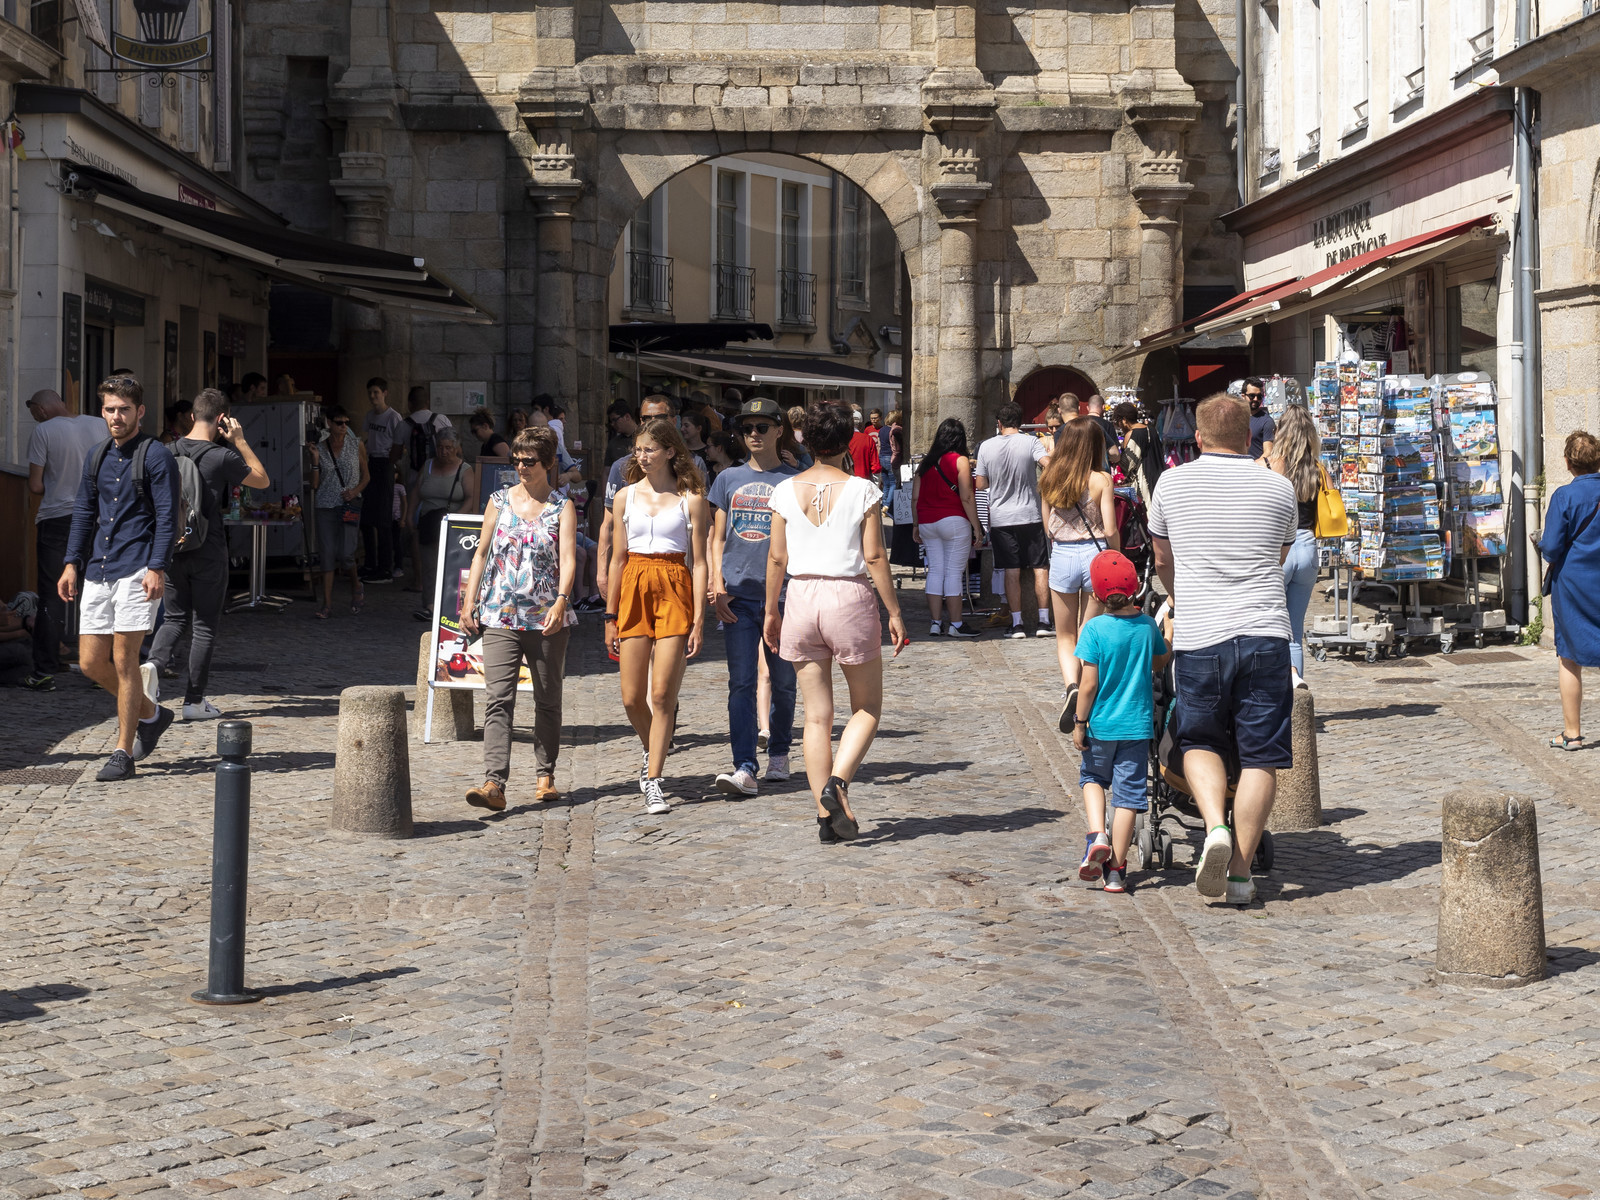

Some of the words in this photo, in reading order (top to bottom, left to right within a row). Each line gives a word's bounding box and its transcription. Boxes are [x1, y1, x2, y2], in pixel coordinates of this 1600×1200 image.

[127, 42, 202, 62] PATISSIER
[1313, 220, 1325, 248] LA
[1326, 201, 1371, 244] BOUTIQUE
